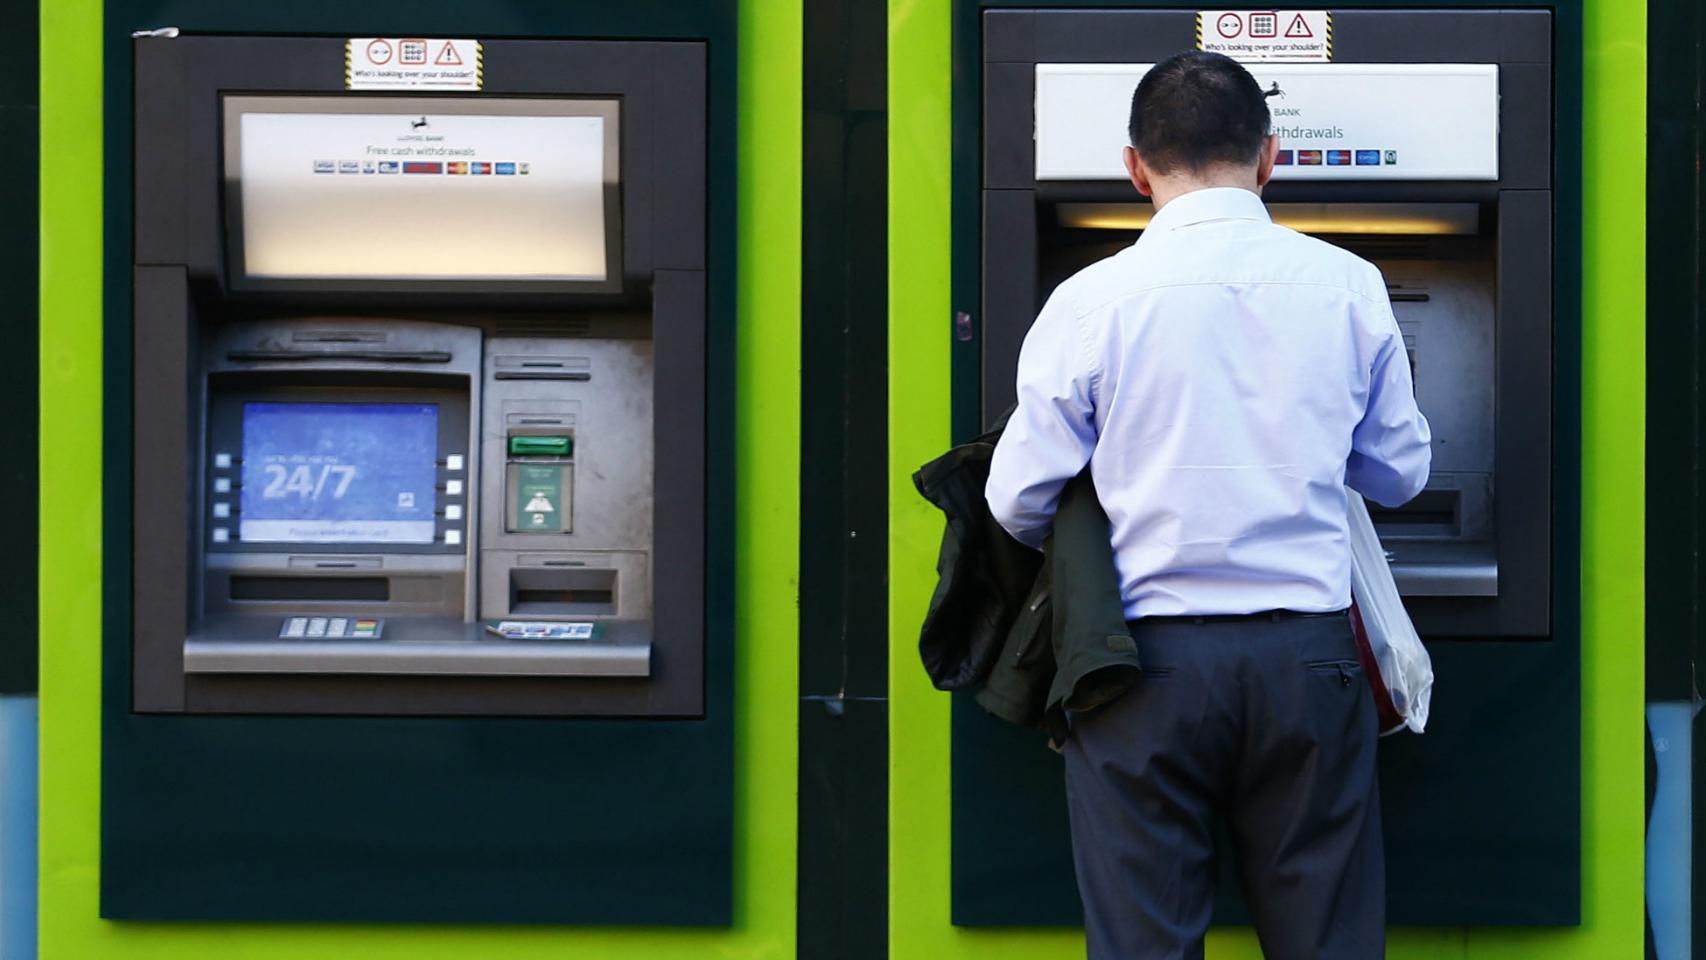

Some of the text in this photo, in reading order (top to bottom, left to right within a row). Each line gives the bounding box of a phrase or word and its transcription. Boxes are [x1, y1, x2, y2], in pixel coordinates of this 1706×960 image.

[1205, 43, 1226, 51] Who's
[1228, 43, 1253, 52] looking
[1272, 44, 1288, 52] your
[1290, 43, 1324, 51] shoulder?
[1273, 108, 1302, 117] BANK
[1272, 125, 1344, 139] ithdrawals
[366, 145, 476, 156] Free cash withdrawals
[262, 464, 357, 500] 24/7
